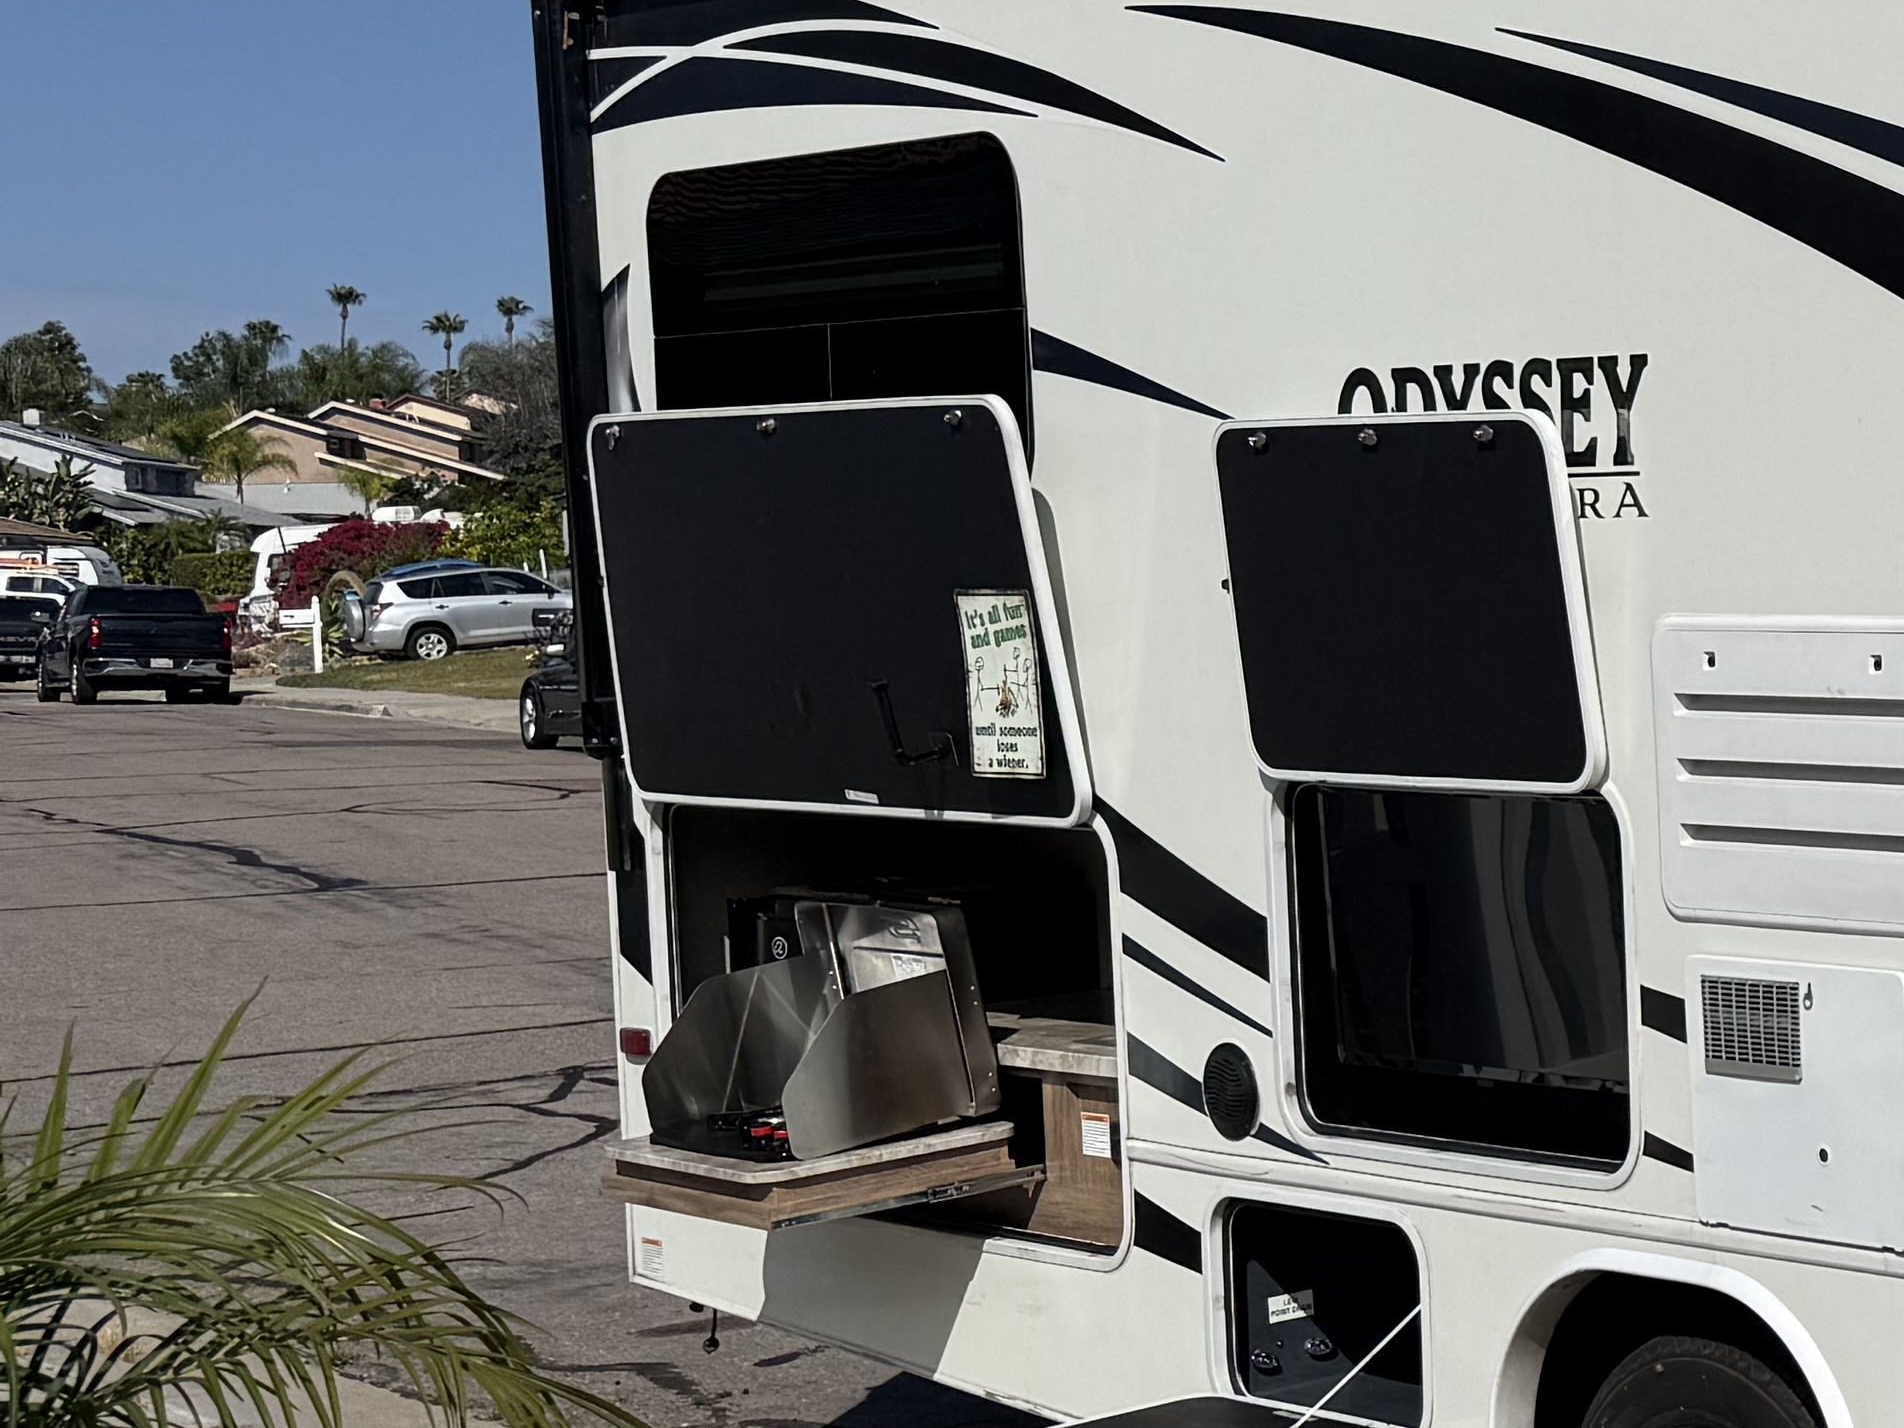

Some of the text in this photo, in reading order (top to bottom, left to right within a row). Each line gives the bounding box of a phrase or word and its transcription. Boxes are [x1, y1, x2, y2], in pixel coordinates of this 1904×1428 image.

[965, 601, 1024, 630] It's all fun
[970, 624, 1027, 650] and games
[975, 723, 1038, 738] until someone
[997, 739, 1018, 753] loses
[988, 758, 994, 768] a
